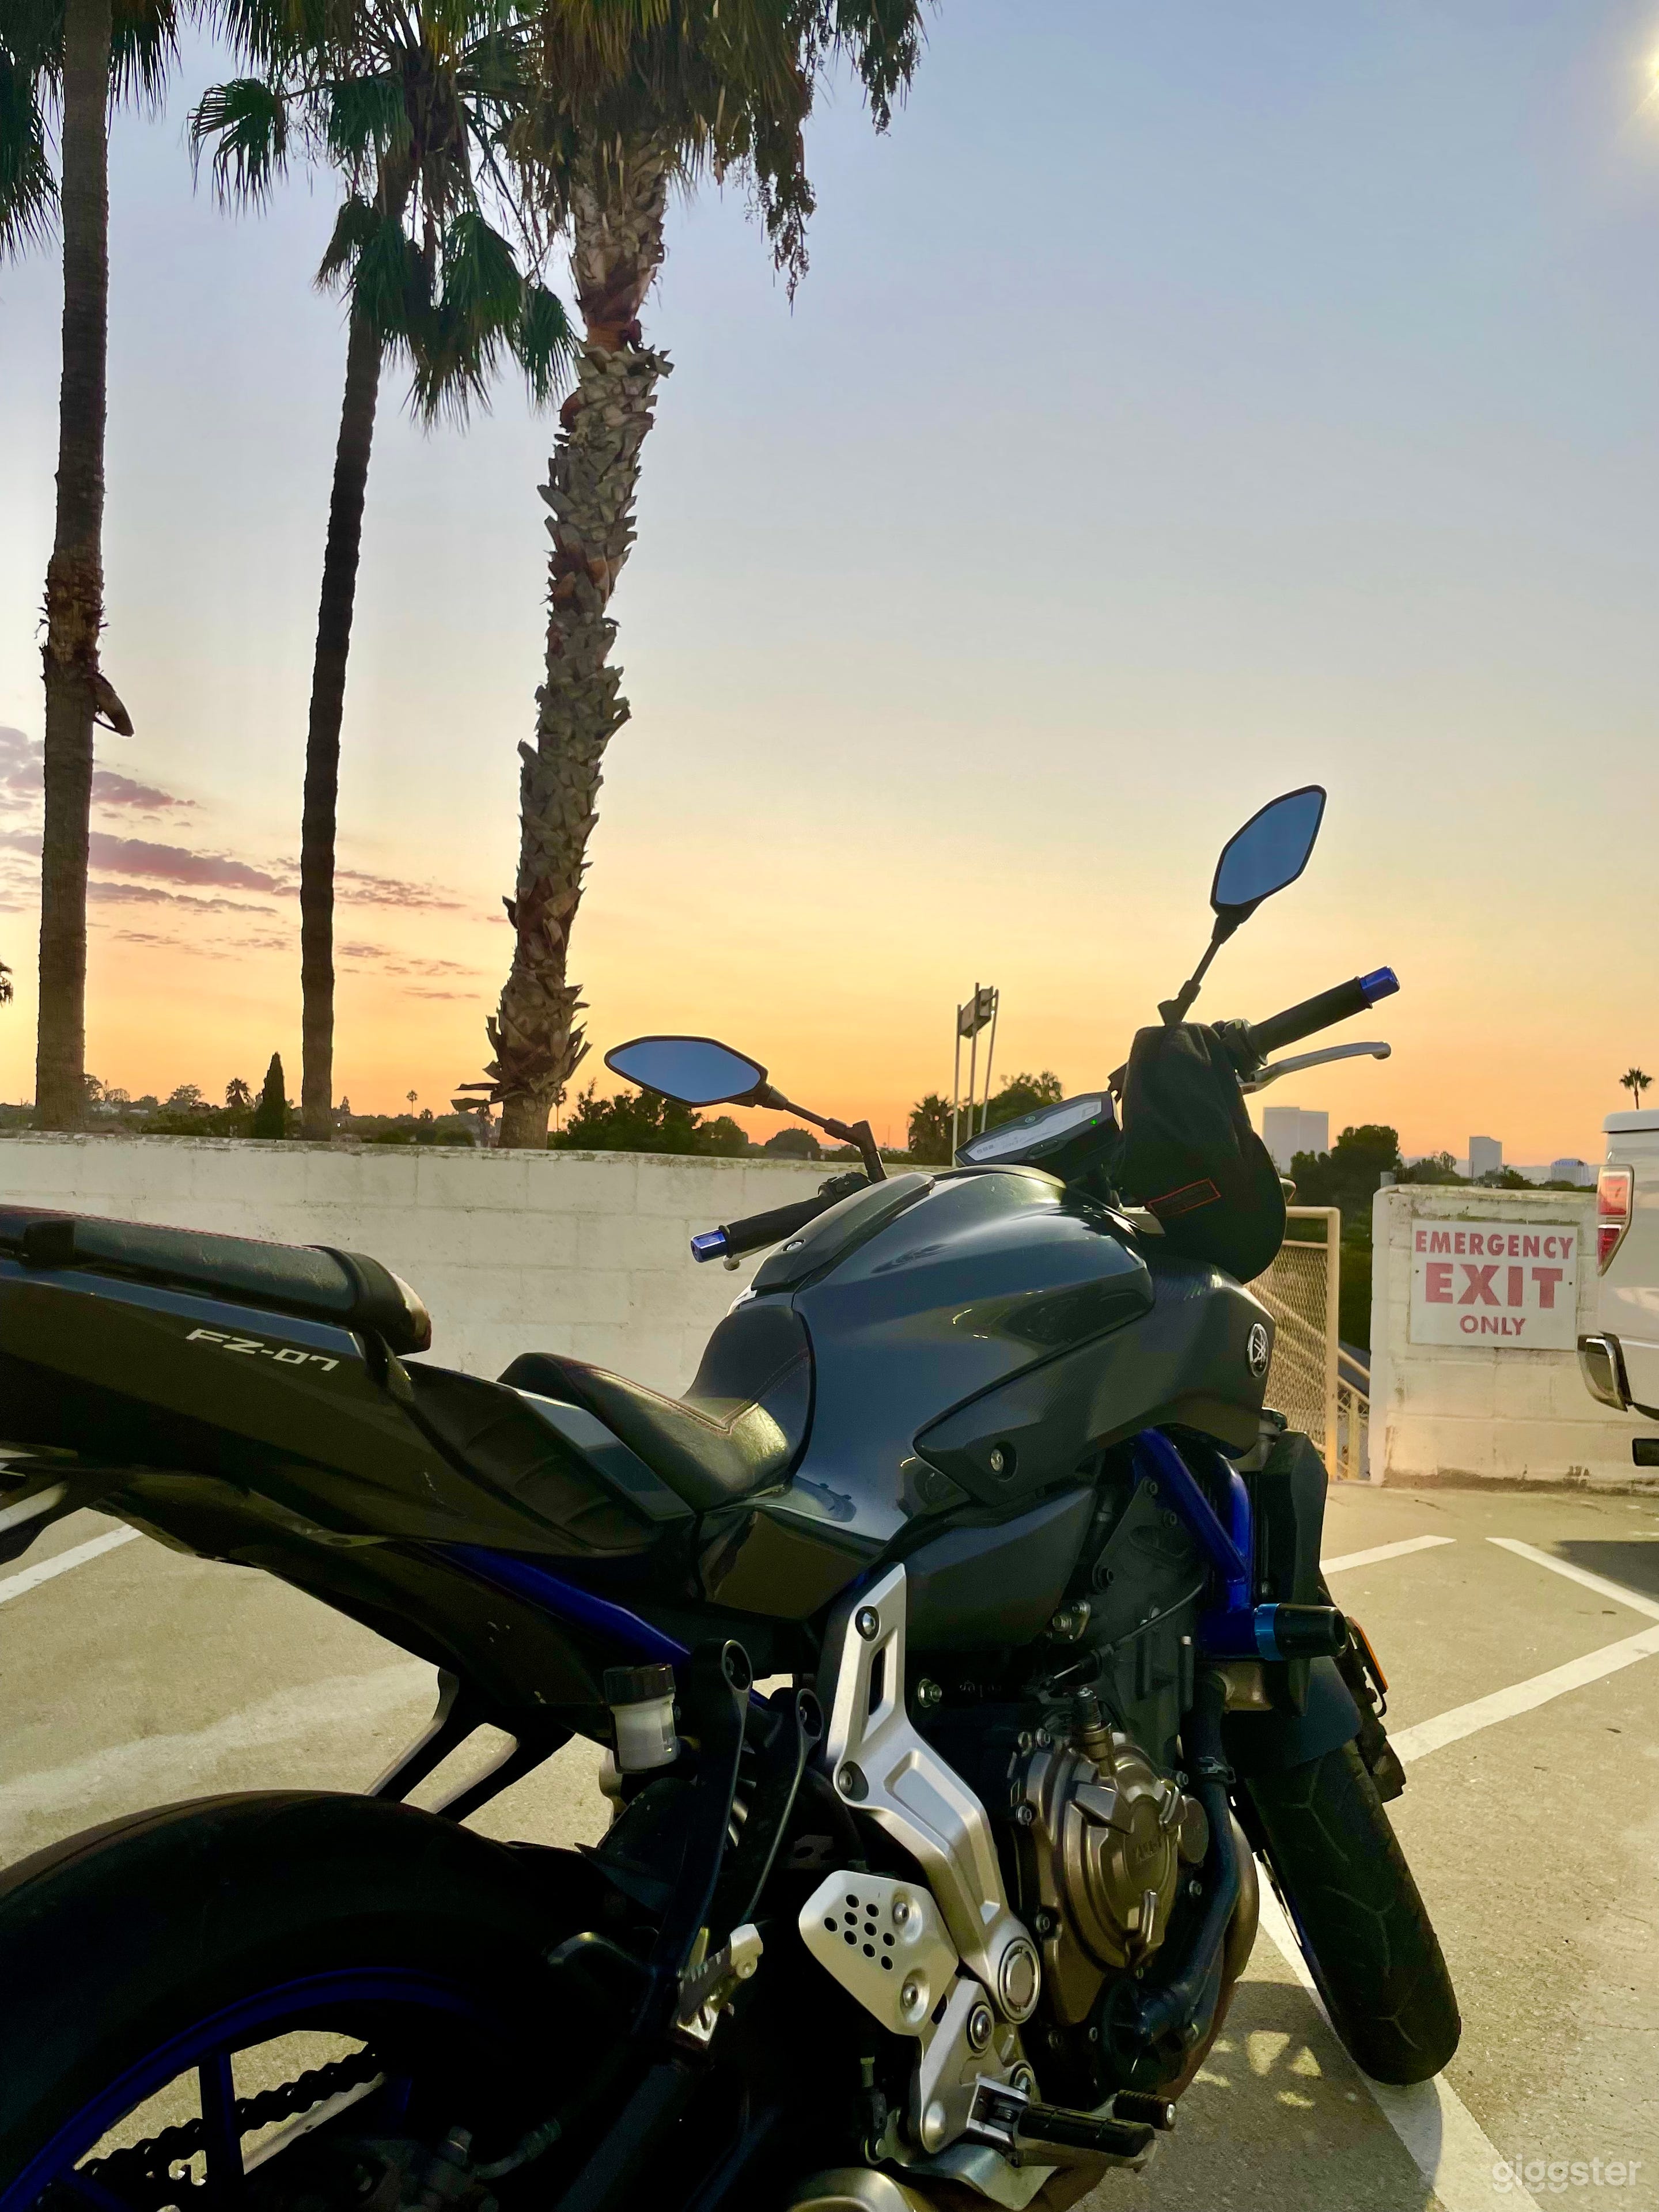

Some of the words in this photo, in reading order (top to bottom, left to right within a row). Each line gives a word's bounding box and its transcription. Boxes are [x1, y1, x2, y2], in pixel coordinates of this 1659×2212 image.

[1415, 1230, 1574, 1260] EMERGENCY
[1425, 1262, 1563, 1309] EXIT
[1460, 1315, 1527, 1336] ONLY
[185, 1328, 340, 1372] FZ-07
